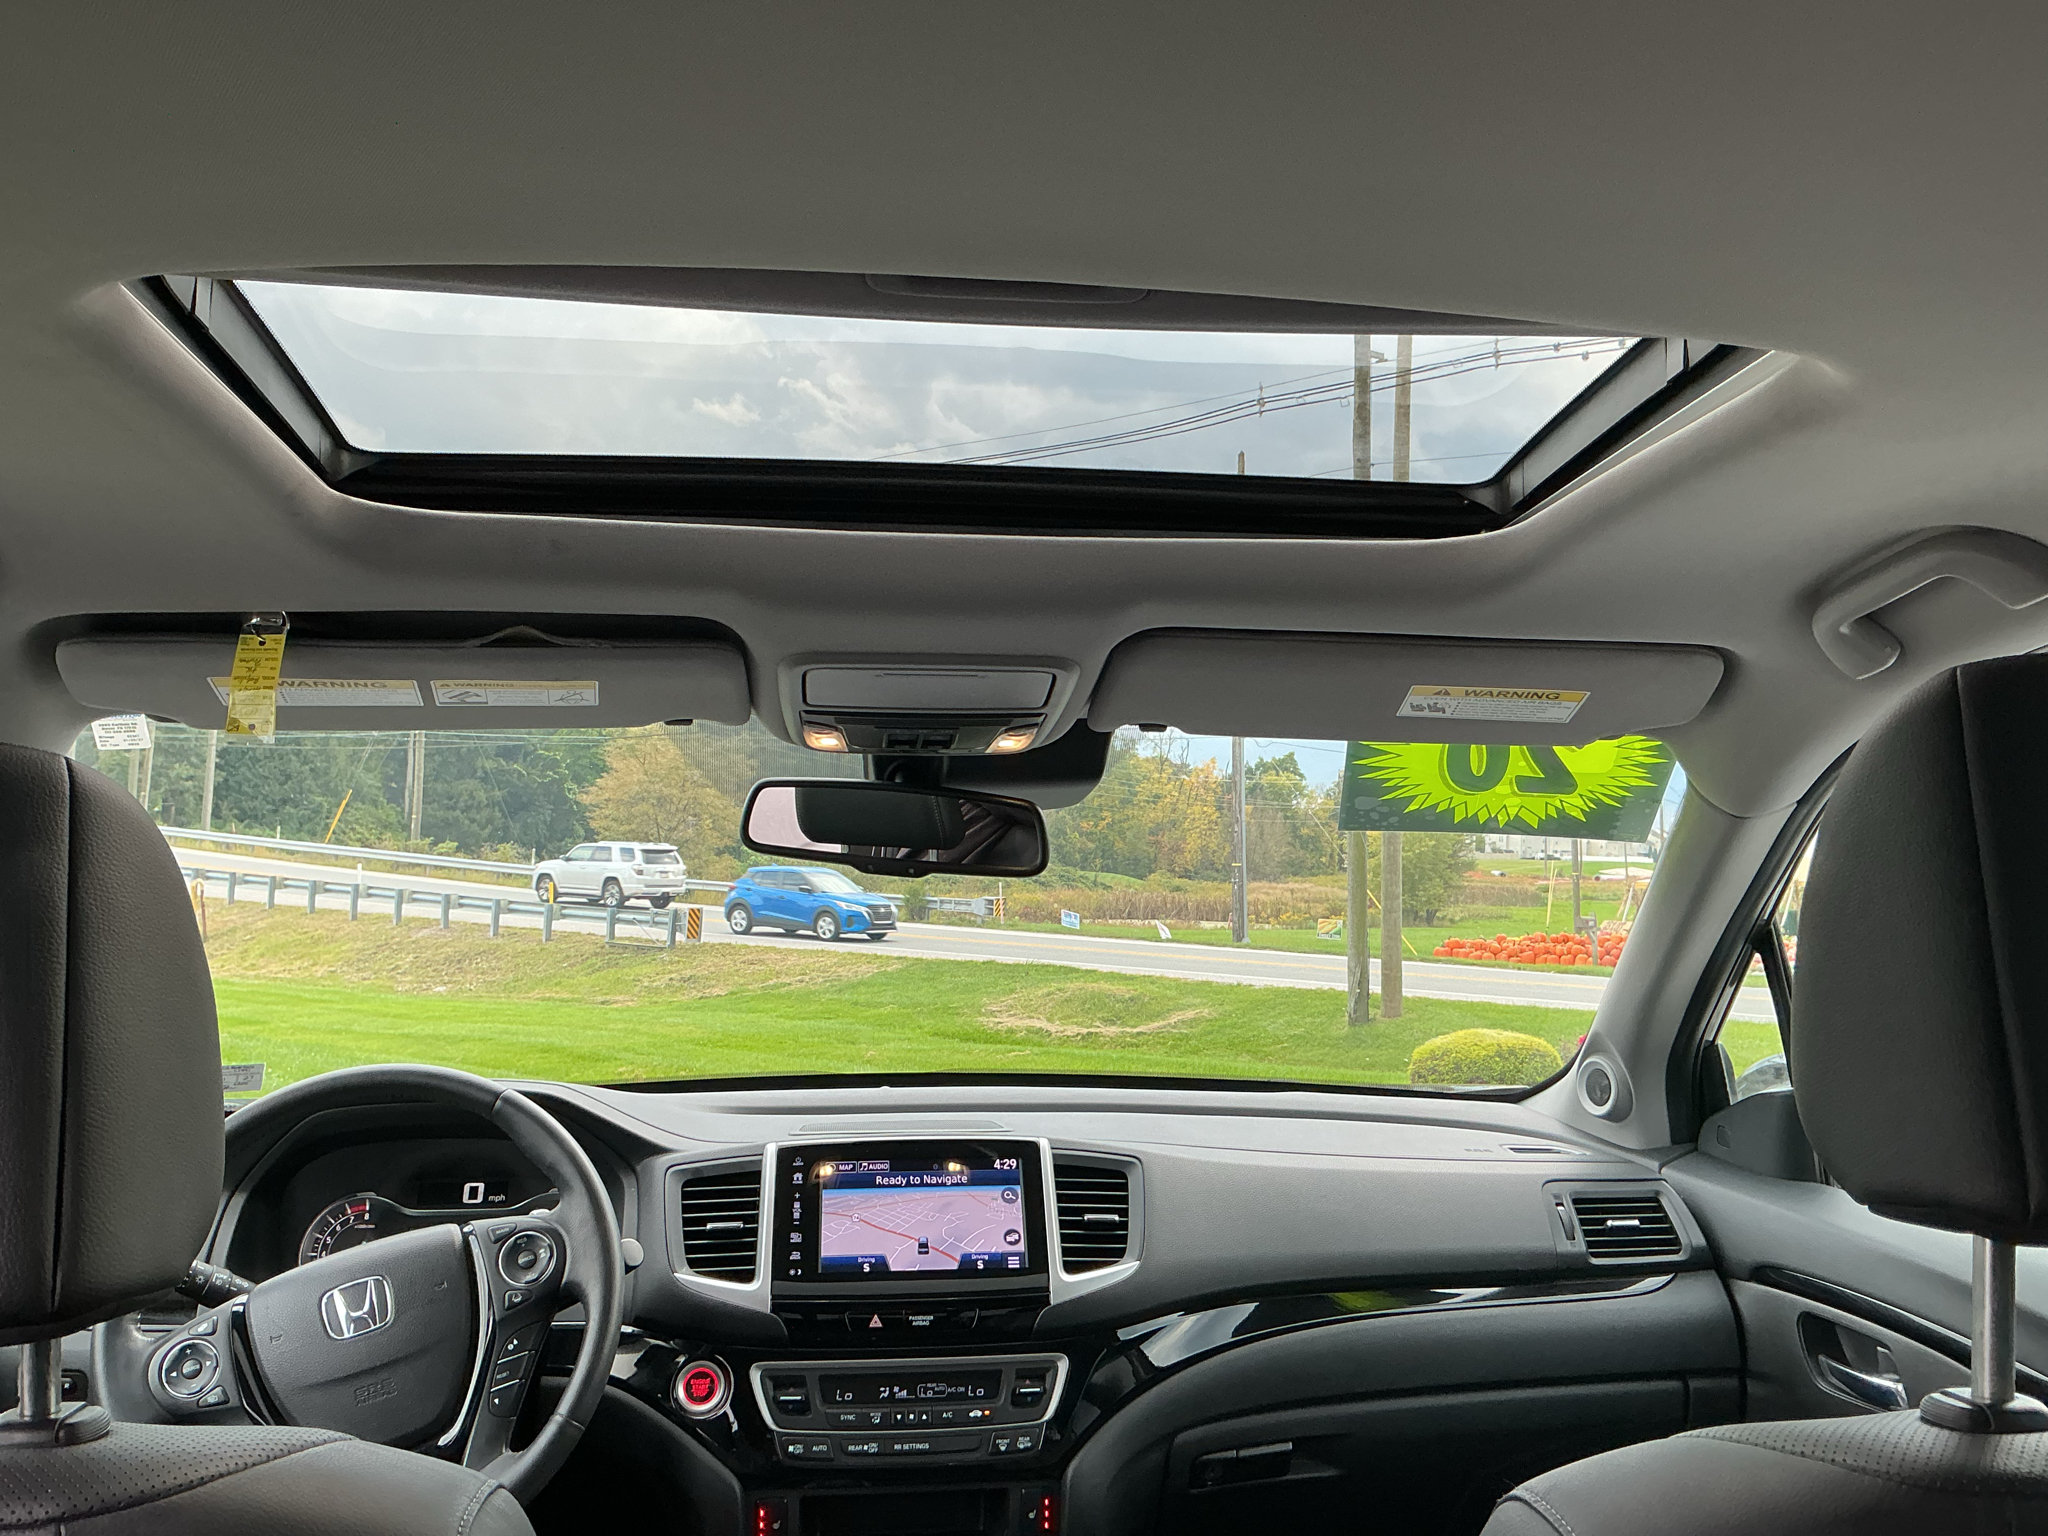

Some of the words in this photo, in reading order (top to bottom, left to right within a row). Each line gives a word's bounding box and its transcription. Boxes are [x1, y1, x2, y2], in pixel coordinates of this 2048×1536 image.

[278, 680, 388, 689] WARNING
[1464, 689, 1561, 700] WARNING
[838, 1163, 854, 1171] MAP
[993, 1158, 1017, 1170] 4:29
[875, 1175, 907, 1187] Ready
[910, 1175, 921, 1185] to
[923, 1173, 968, 1186] Navigate
[463, 1182, 485, 1204] 0
[488, 1193, 506, 1203] mph
[349, 1215, 355, 1224] 7
[364, 1212, 370, 1221] 8
[335, 1223, 341, 1232] 6
[326, 1236, 332, 1244] 5
[857, 1256, 876, 1264] Driving
[976, 1260, 984, 1269] S
[862, 1263, 870, 1272] S
[812, 1444, 828, 1452] AUTO
[848, 1444, 863, 1452] REAR
[903, 1442, 930, 1450] SETTINGS
